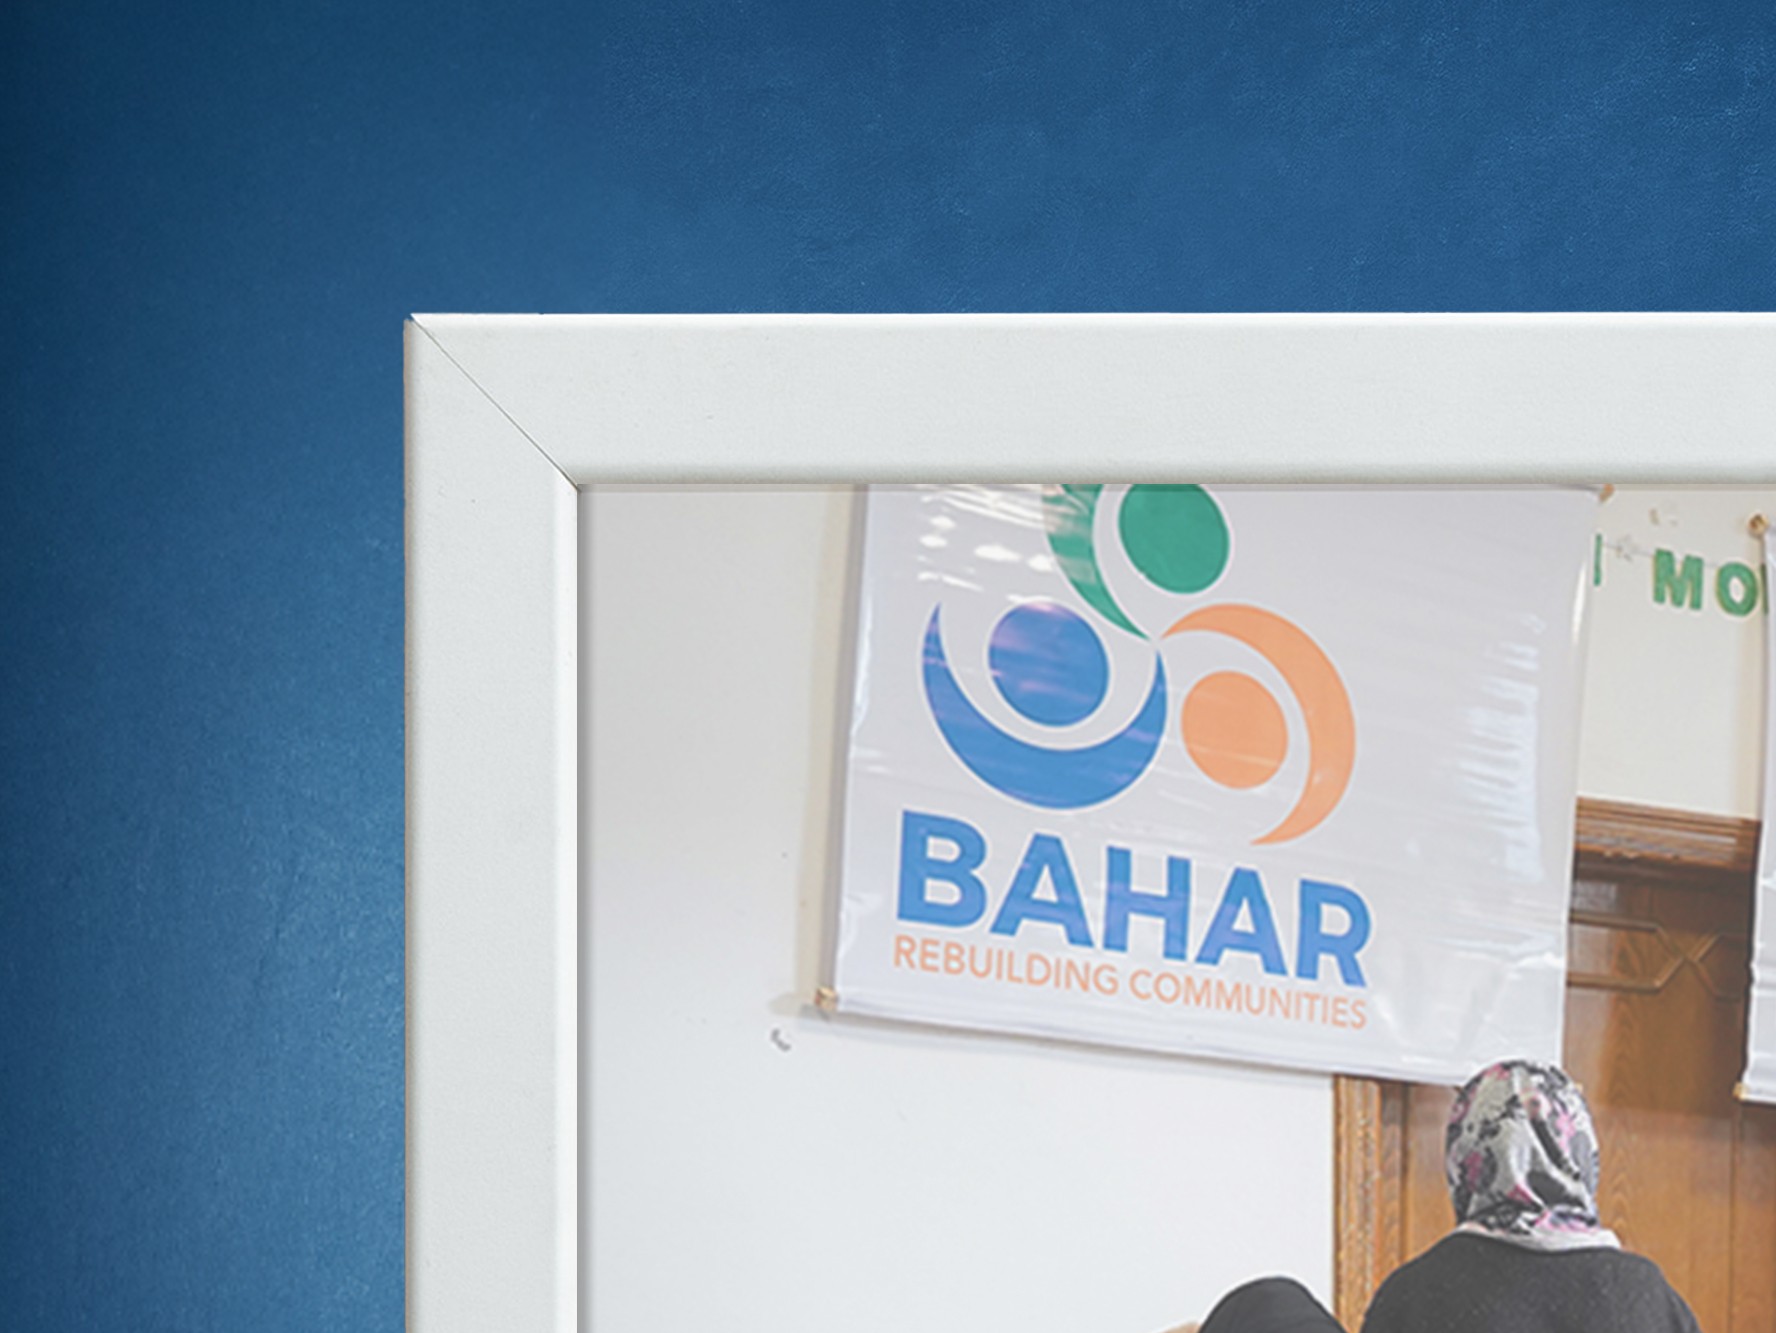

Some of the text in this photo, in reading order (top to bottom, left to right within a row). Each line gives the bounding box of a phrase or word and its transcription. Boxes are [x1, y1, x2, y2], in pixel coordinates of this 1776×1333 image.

[1653, 548, 1770, 617] MO
[897, 809, 1371, 988] BAHAR
[894, 935, 1367, 1030] REBUILDING COMMUNITIES
